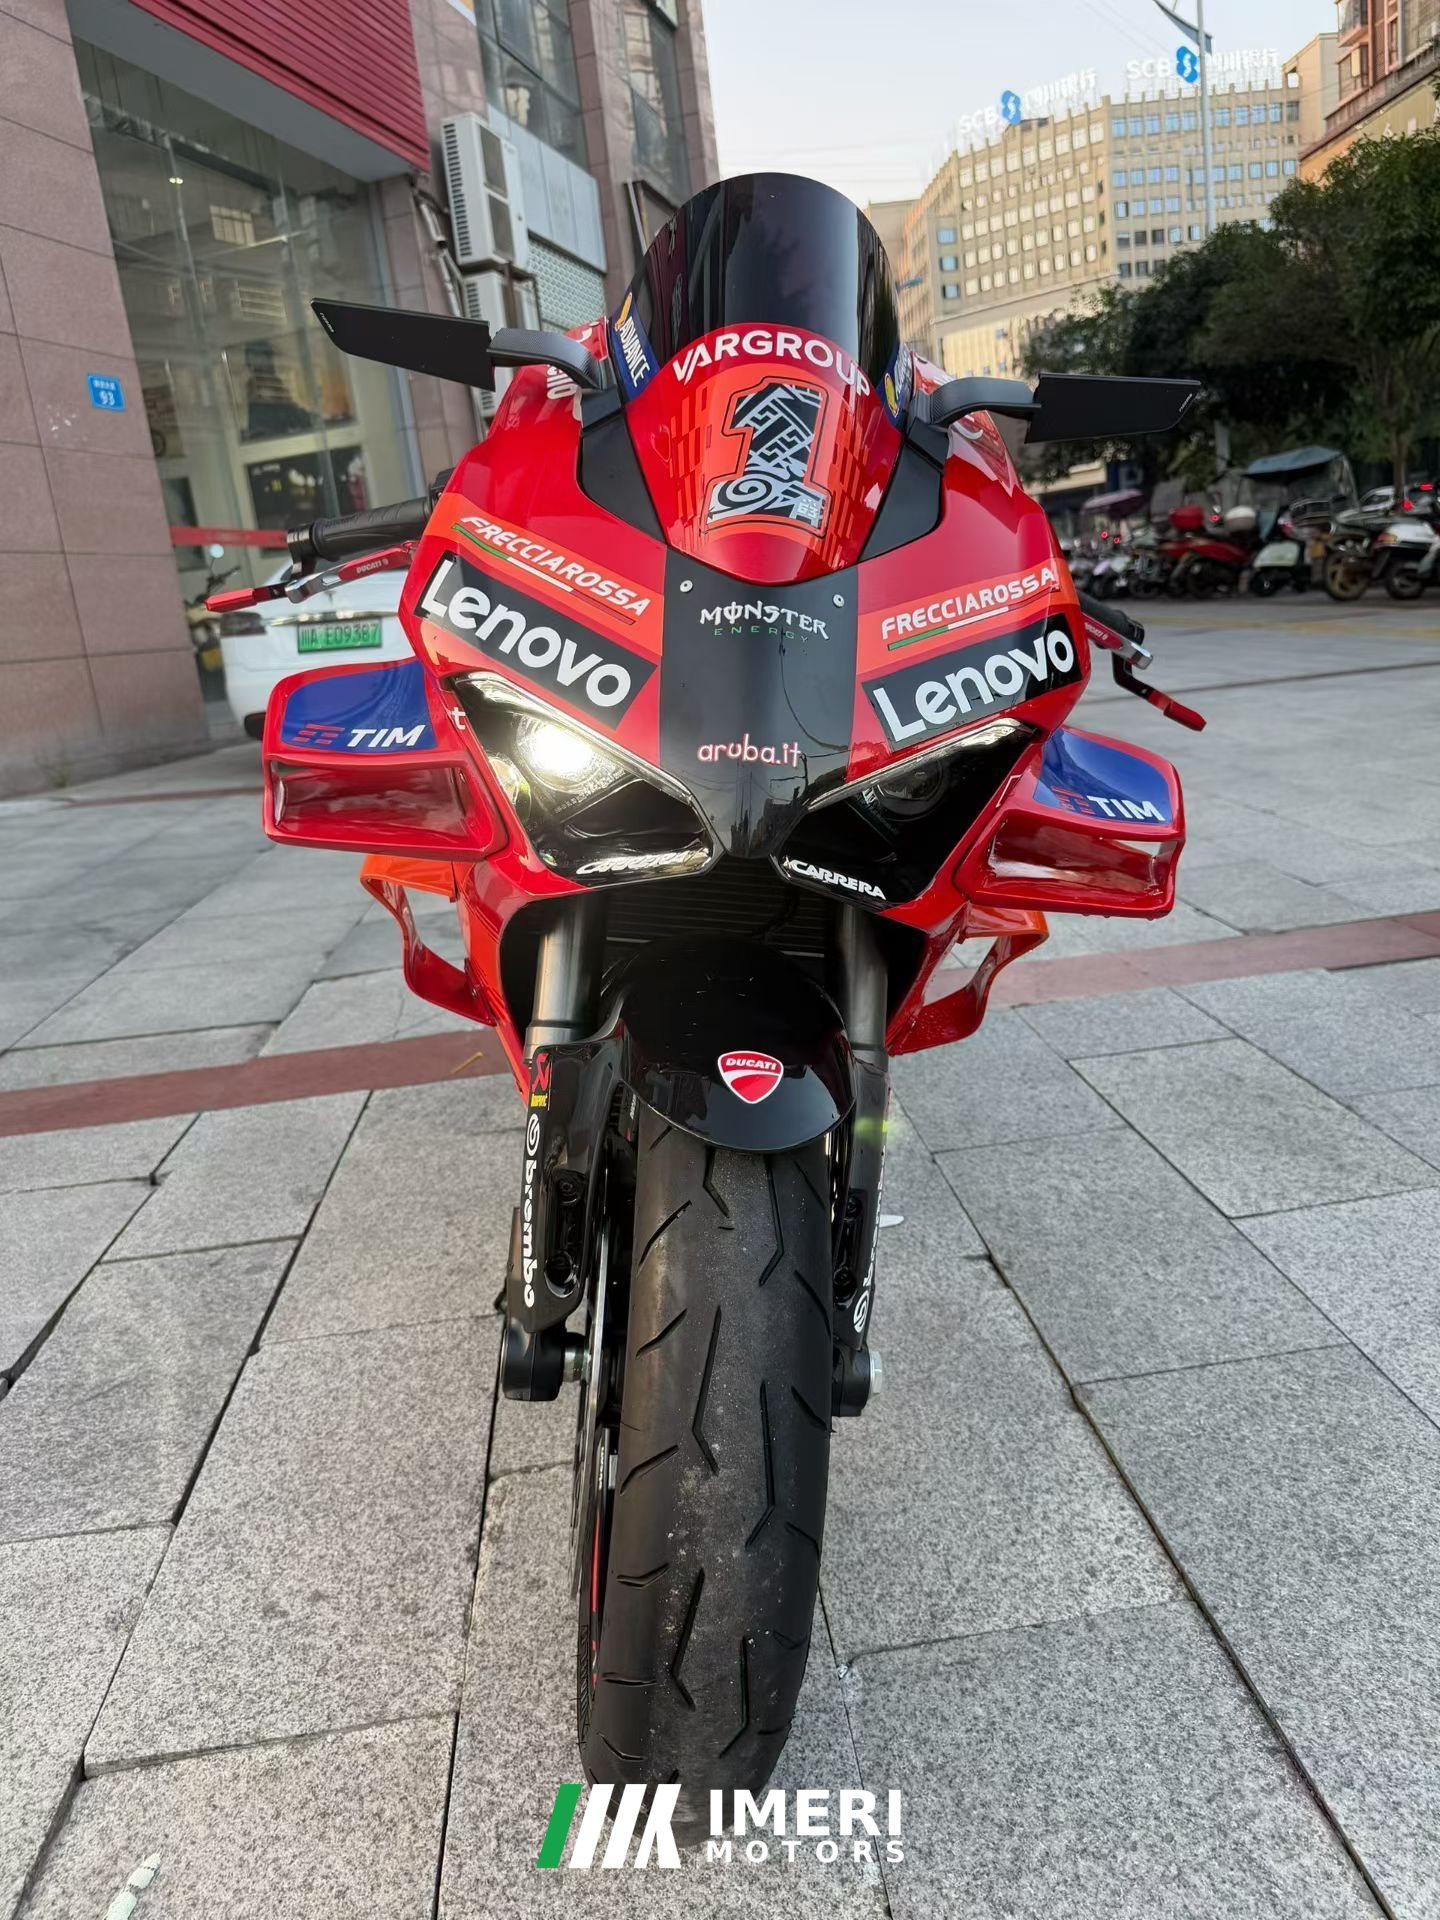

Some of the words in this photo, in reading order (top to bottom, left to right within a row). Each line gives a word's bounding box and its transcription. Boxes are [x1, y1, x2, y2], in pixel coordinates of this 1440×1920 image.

[1125, 57, 1170, 80] SCB
[959, 104, 998, 134] SCB
[619, 316, 651, 388] ADVANCE
[672, 329, 871, 397] VARGROUP
[459, 515, 652, 617] FRECCIAROSSA
[881, 566, 1058, 641] FRECCIAROSSA
[420, 559, 631, 707] Lenovo
[714, 625, 808, 643] ENERGY
[873, 629, 1075, 742] Lenovo
[346, 724, 426, 749] TIM
[697, 732, 802, 768] aruba.it
[1086, 794, 1166, 822] TIM
[791, 858, 887, 900] CARRERA
[725, 1057, 777, 1071] DUCATI
[522, 1159, 539, 1308] brembo
